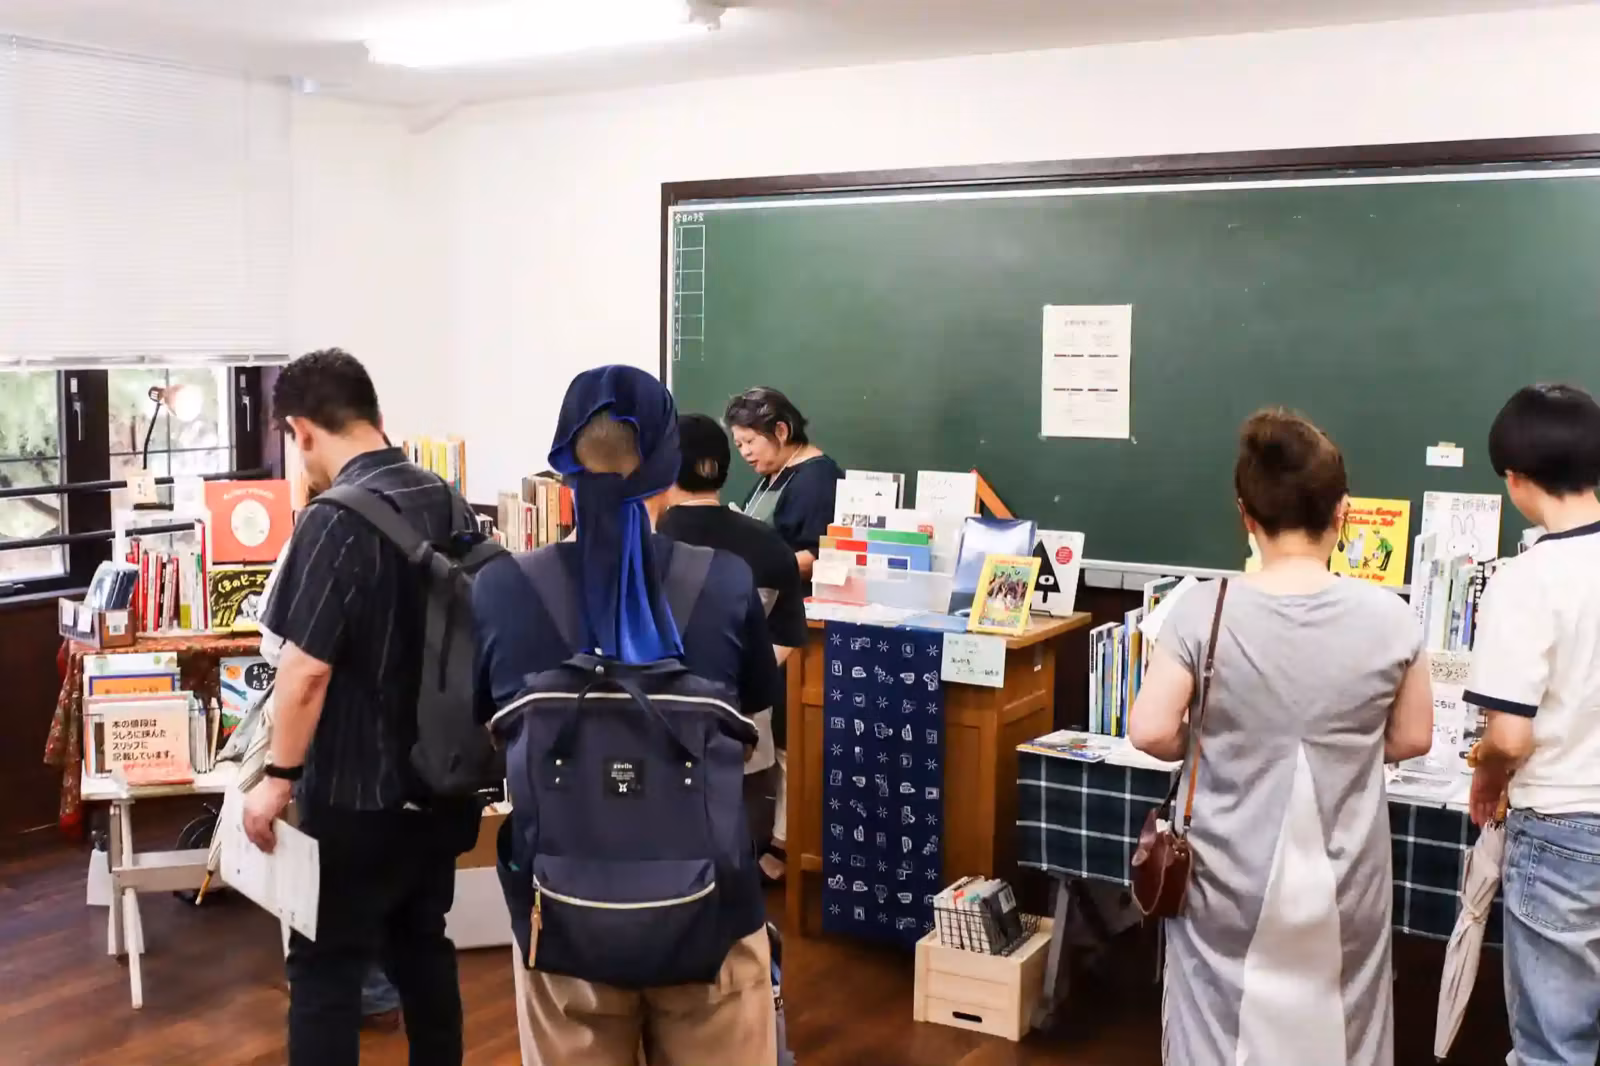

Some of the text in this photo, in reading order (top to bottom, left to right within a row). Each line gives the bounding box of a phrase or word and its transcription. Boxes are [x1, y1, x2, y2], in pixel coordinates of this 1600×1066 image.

[112, 719, 157, 729] 本の値段は
[112, 742, 149, 751] スリップに
[112, 750, 175, 762] 記載しています。
